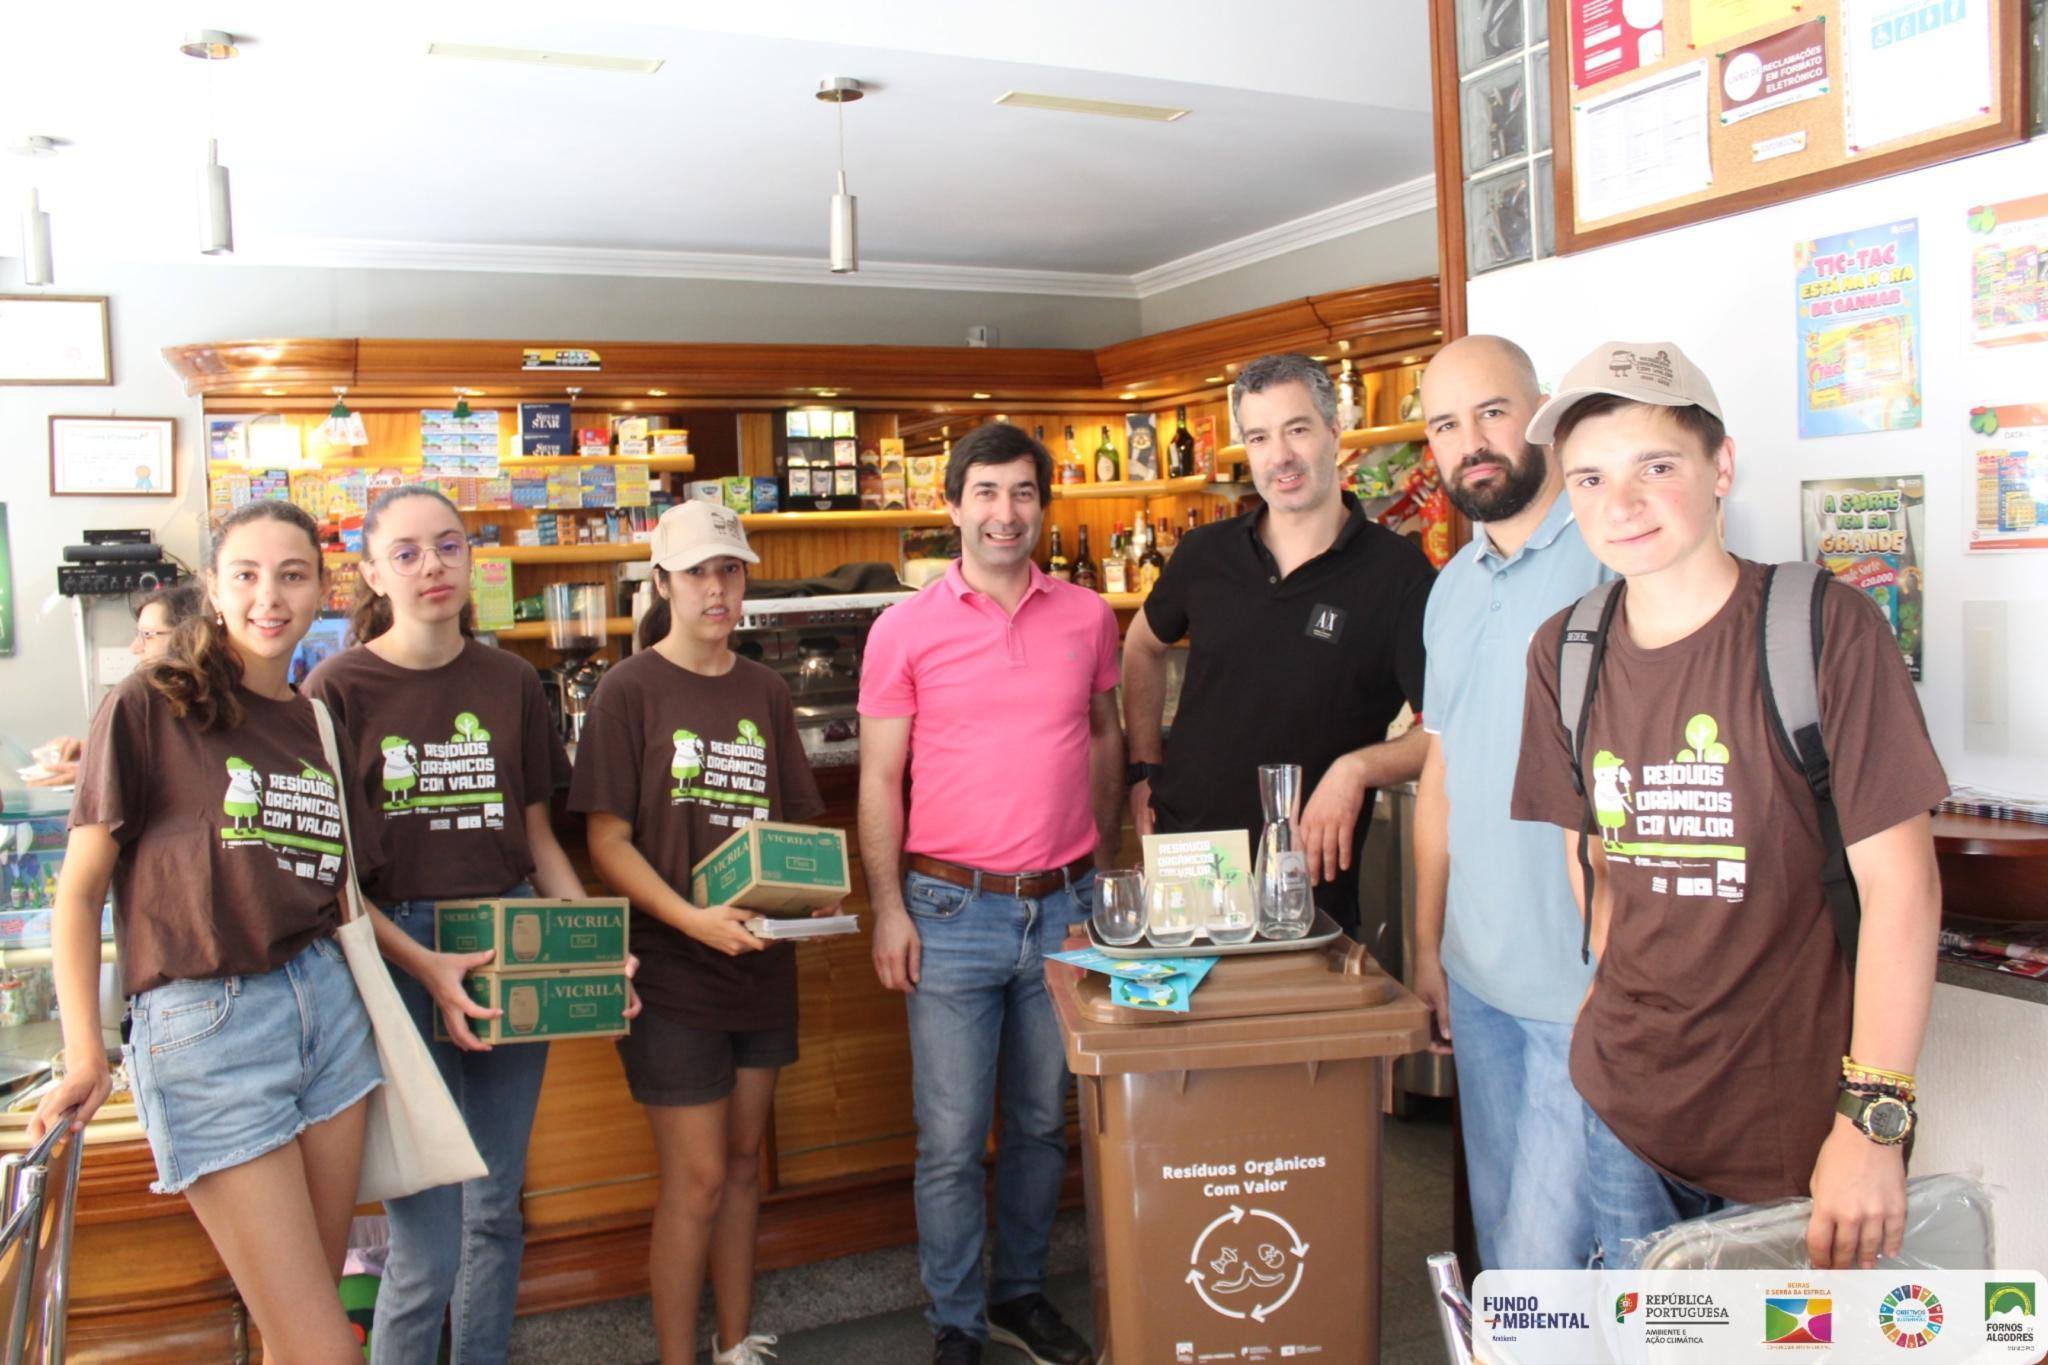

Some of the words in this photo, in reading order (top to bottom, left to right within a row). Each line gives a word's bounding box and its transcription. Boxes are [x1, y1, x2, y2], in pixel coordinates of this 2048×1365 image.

[1762, 45, 1822, 71] RECLAMAÇÕES
[1780, 55, 1823, 77] FORMATO
[1765, 67, 1823, 94] ELETRÓNICO
[1814, 244, 1896, 278] TIC-TAC
[1801, 275, 1841, 300] ESTÁ
[1842, 276, 1865, 292] NA
[1810, 301, 1833, 318] DE
[1834, 288, 1901, 314] GANHAR
[531, 420, 560, 429] STAR
[1834, 514, 1864, 530] VEM
[1867, 513, 1889, 529] EM
[1819, 530, 1907, 554] GRANDE
[710, 740, 765, 761] RESÍDUOS
[706, 755, 767, 778] ORGÂNICOS
[269, 773, 336, 800] RESÍDUOS
[448, 774, 496, 791] VALOR
[704, 771, 728, 788] COM
[731, 775, 766, 793] VALOR
[265, 790, 340, 820] ORGÂNICOS
[263, 809, 292, 830] COM
[296, 815, 341, 838] VALOR
[1668, 815, 1734, 838] VALOR
[766, 833, 814, 846] VICRILA
[713, 840, 750, 873] VICRILA
[555, 914, 623, 929] VICRILA
[554, 983, 624, 999] VICRILA
[1162, 1163, 1237, 1180] Resíduos
[1244, 1154, 1327, 1176] Orgânicos
[1203, 1183, 1240, 1198] Com
[1243, 1179, 1288, 1195] Valor
